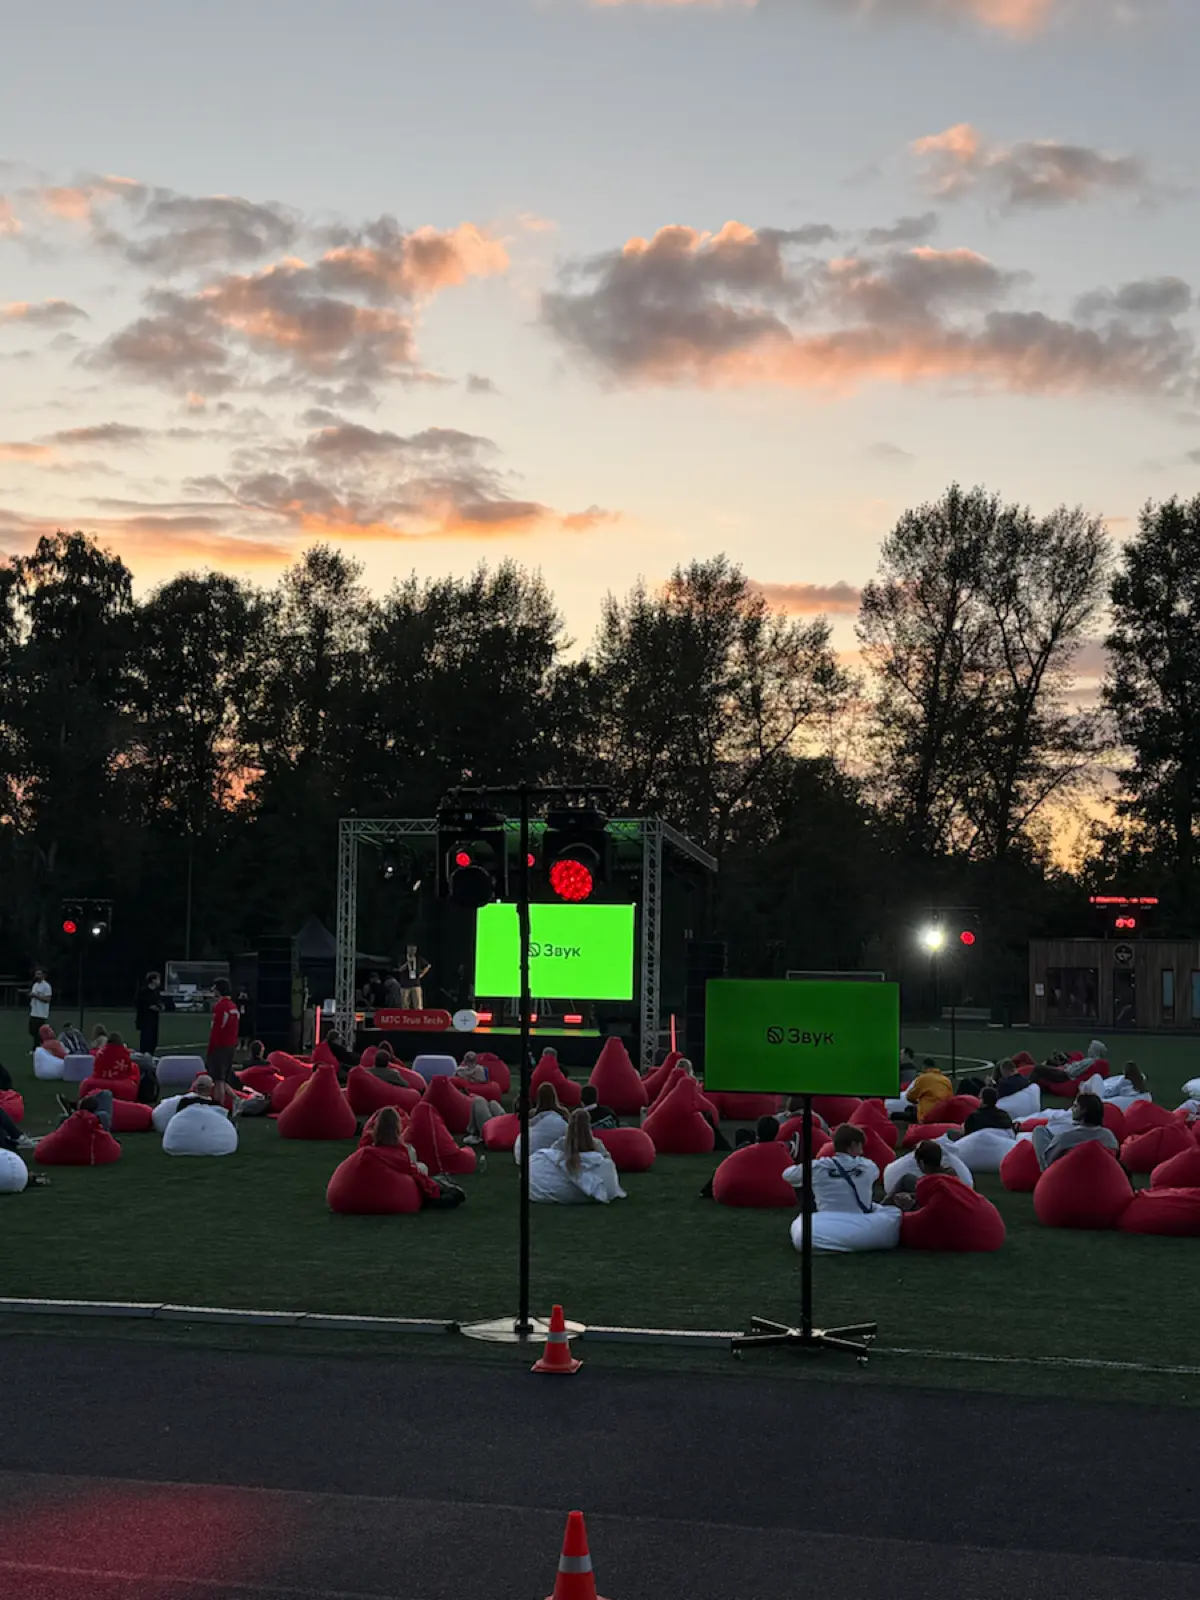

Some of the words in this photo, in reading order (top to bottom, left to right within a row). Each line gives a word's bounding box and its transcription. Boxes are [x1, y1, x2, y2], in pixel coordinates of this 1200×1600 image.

[543, 943, 581, 960] Звук
[402, 1015, 421, 1025] True
[423, 1016, 444, 1025] Tech
[787, 1028, 834, 1047] Звук
